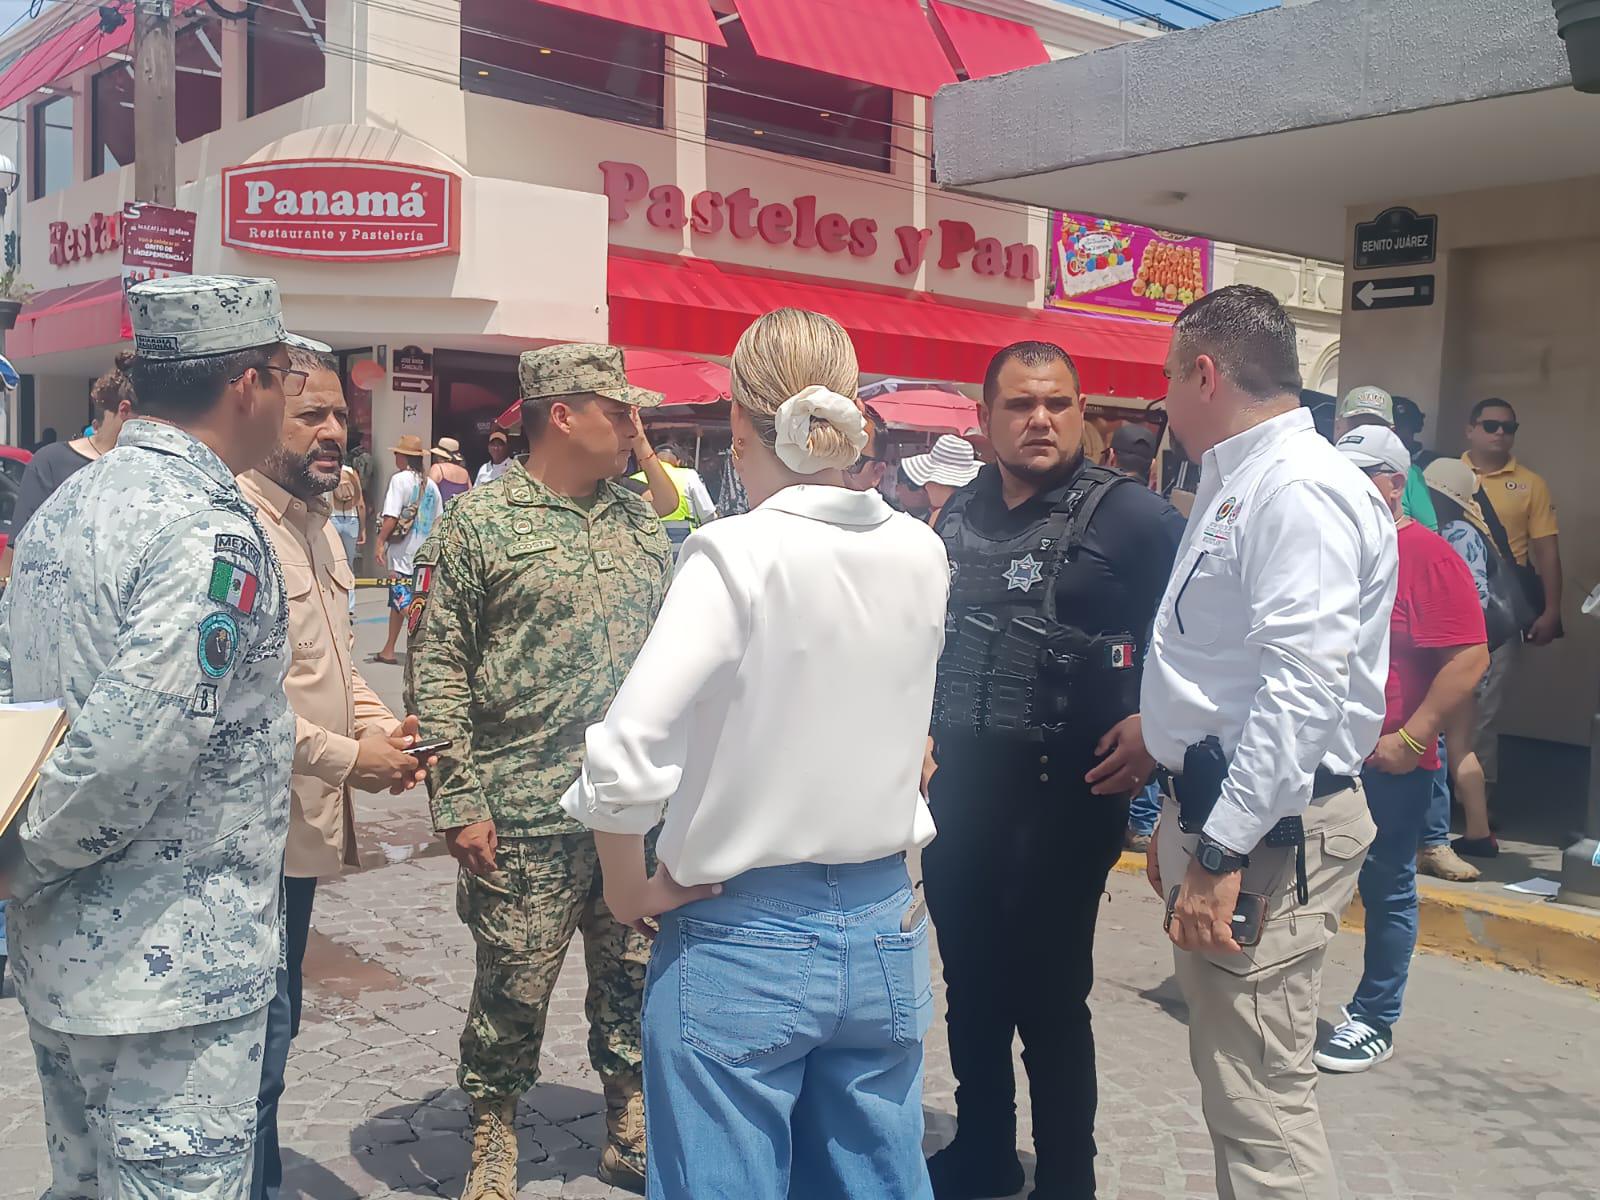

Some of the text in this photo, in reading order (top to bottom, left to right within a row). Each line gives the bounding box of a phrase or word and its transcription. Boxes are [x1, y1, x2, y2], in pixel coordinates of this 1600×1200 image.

[244, 180, 426, 218] Panamá
[249, 227, 424, 241] Restaurante y Pastelería
[598, 160, 1039, 280] Pasteles y Pan
[1362, 234, 1429, 253] BENITO JUÁREZ
